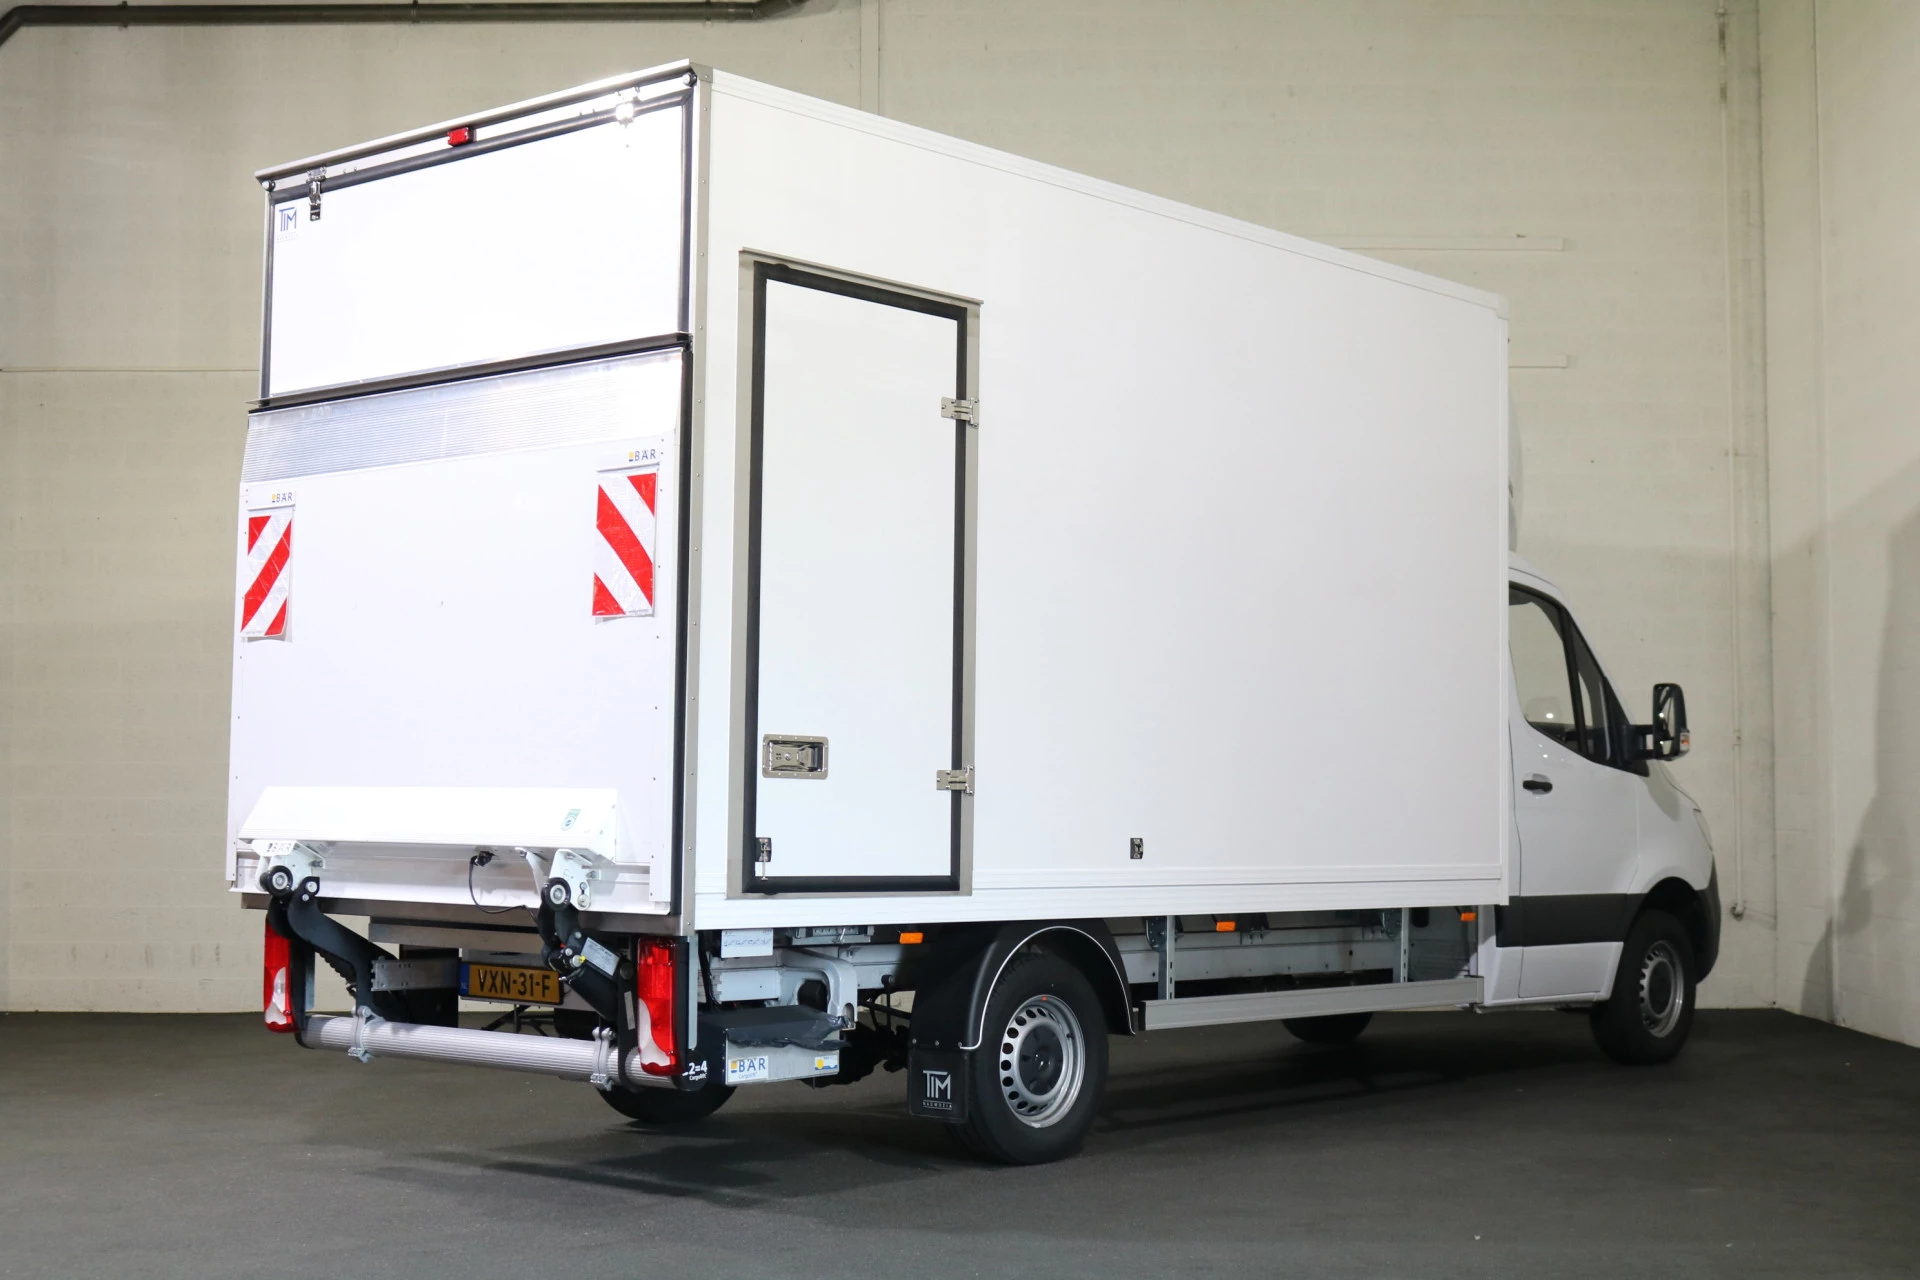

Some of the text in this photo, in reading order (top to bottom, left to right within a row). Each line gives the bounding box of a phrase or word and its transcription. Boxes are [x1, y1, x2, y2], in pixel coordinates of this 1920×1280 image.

[635, 448, 656, 462] BÄR
[276, 492, 293, 503] BÄR
[477, 969, 551, 997] VXN-31-F
[738, 1057, 766, 1073] BÄR
[922, 1069, 951, 1100] TIM
